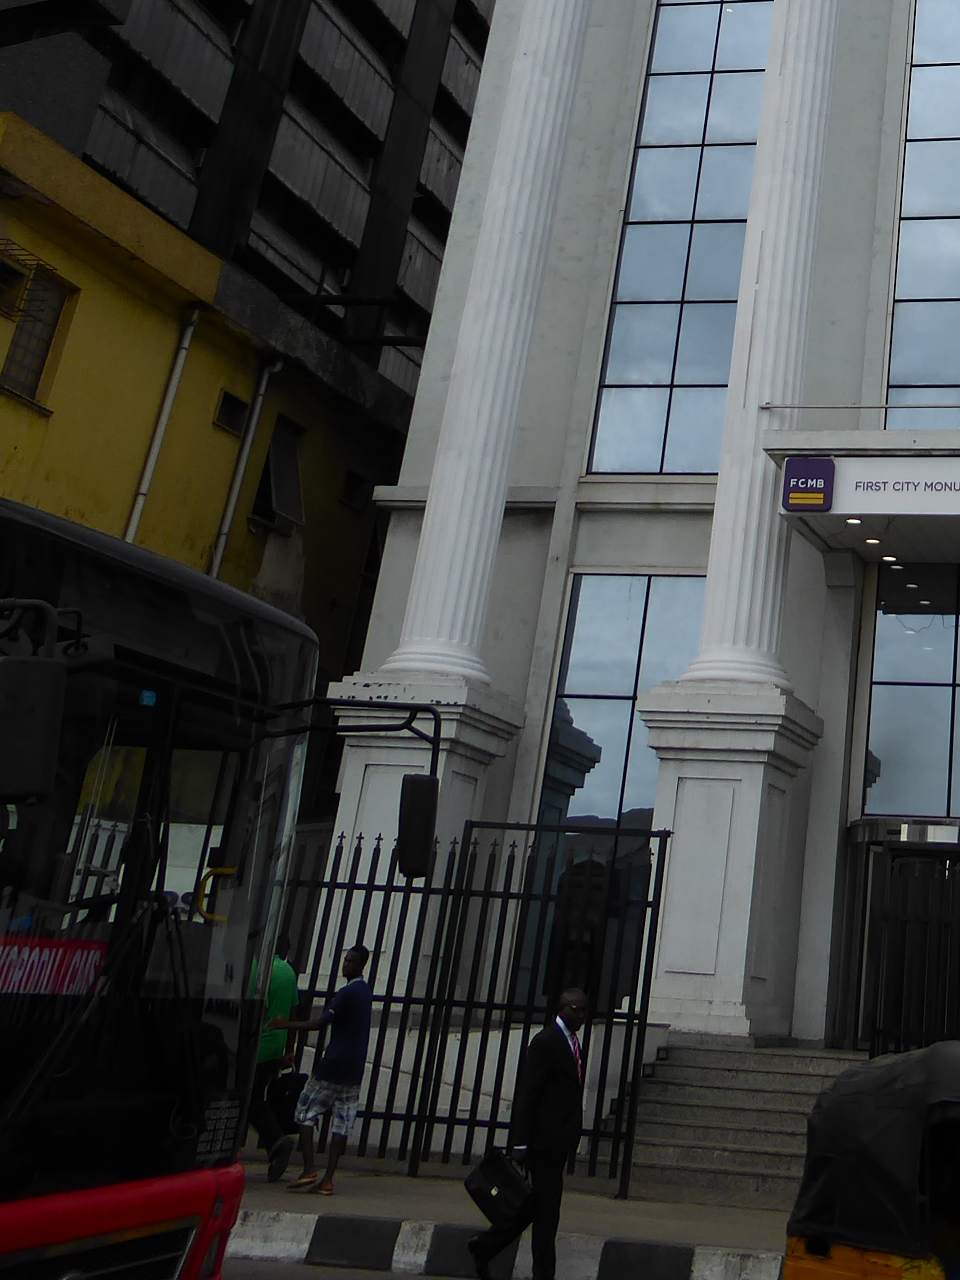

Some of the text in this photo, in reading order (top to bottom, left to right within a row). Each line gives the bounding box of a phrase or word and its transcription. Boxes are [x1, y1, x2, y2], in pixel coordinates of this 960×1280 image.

[789, 478, 825, 488] FCMB
[855, 481, 888, 491] FIRST
[892, 481, 920, 491] CITY
